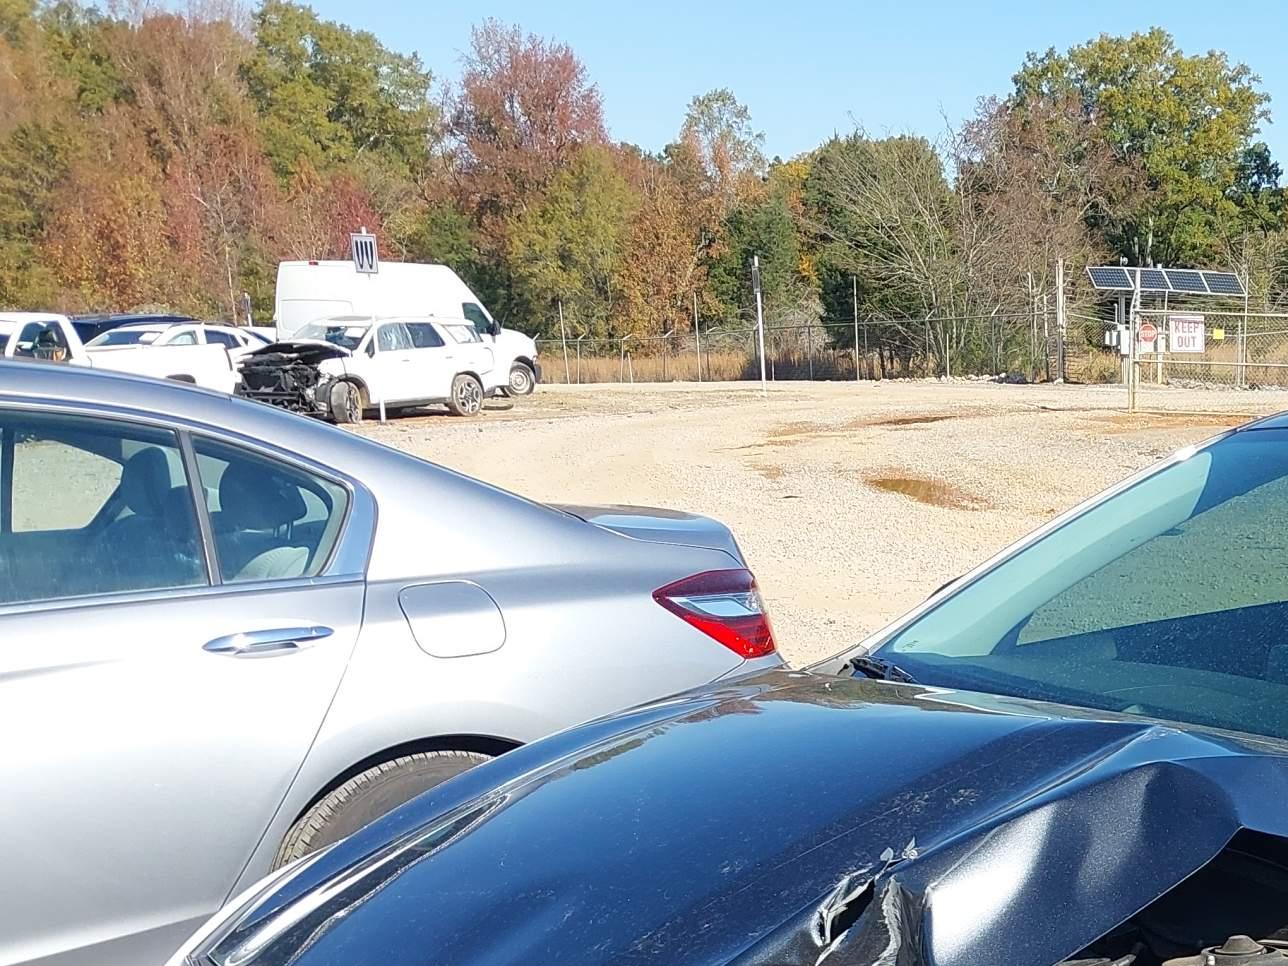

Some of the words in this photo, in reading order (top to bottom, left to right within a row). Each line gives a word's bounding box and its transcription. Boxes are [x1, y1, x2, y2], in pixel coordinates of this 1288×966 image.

[1174, 320, 1199, 333] KEEP
[1140, 330, 1156, 338] STOP
[1177, 335, 1197, 348] OUT
